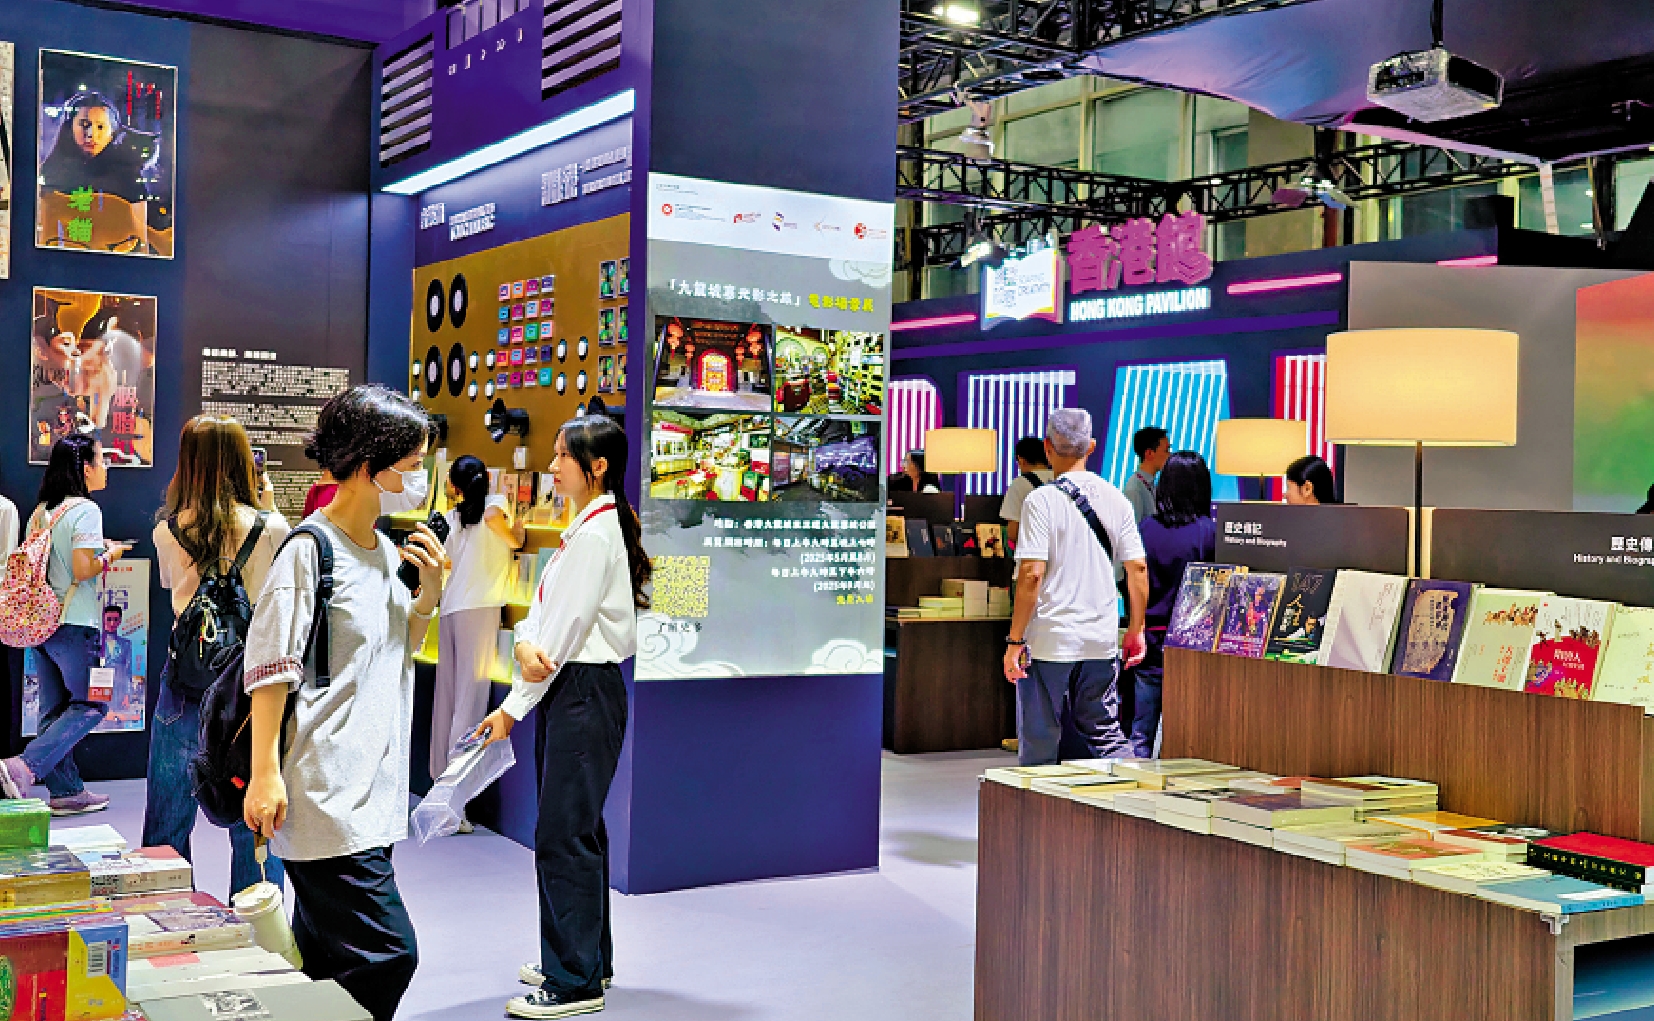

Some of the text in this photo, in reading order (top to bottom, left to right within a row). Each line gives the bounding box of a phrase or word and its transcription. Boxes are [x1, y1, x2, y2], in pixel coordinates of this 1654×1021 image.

[1069, 287, 1211, 323] HONG KONG PAVILION
[1224, 535, 1287, 548] History and Biography
[1573, 553, 1604, 564] History
[1606, 554, 1622, 564] and
